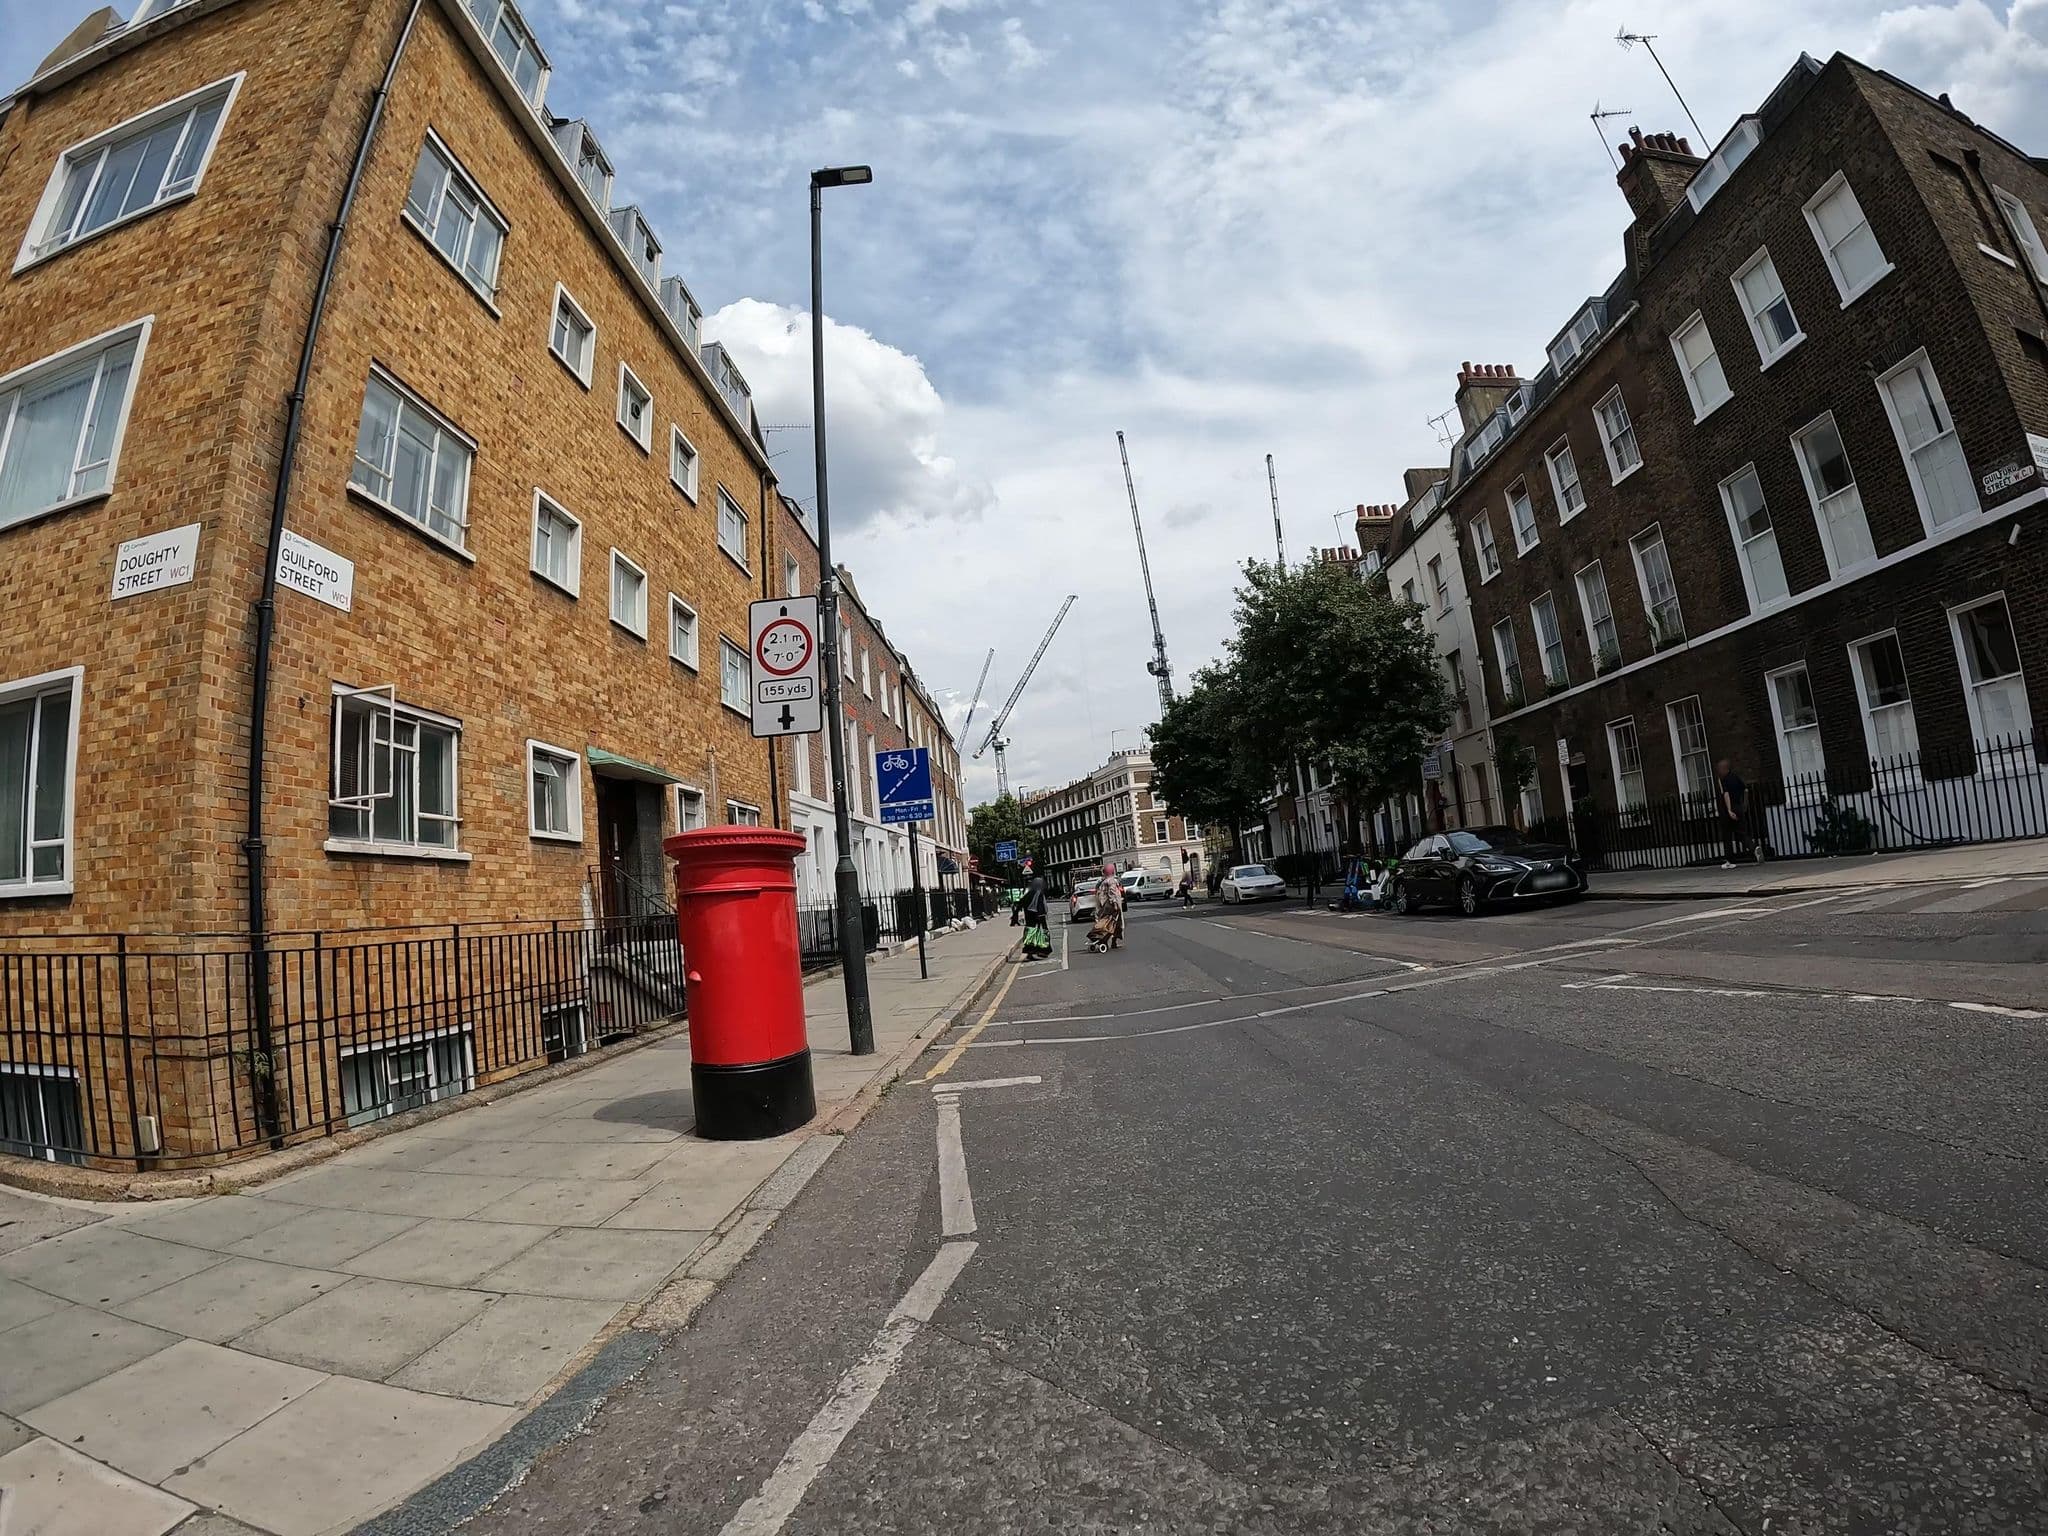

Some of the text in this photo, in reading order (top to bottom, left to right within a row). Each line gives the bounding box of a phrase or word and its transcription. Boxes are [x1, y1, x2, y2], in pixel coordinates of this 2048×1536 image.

[1986, 476, 2011, 494] STREET
[120, 545, 180, 572] DOUGHTY
[281, 548, 339, 583] GUILFORD
[118, 565, 190, 591] STREET WC1
[279, 565, 349, 606] STREET WC1
[769, 632, 802, 645] 2.1 m
[764, 683, 807, 696] 155 yds
